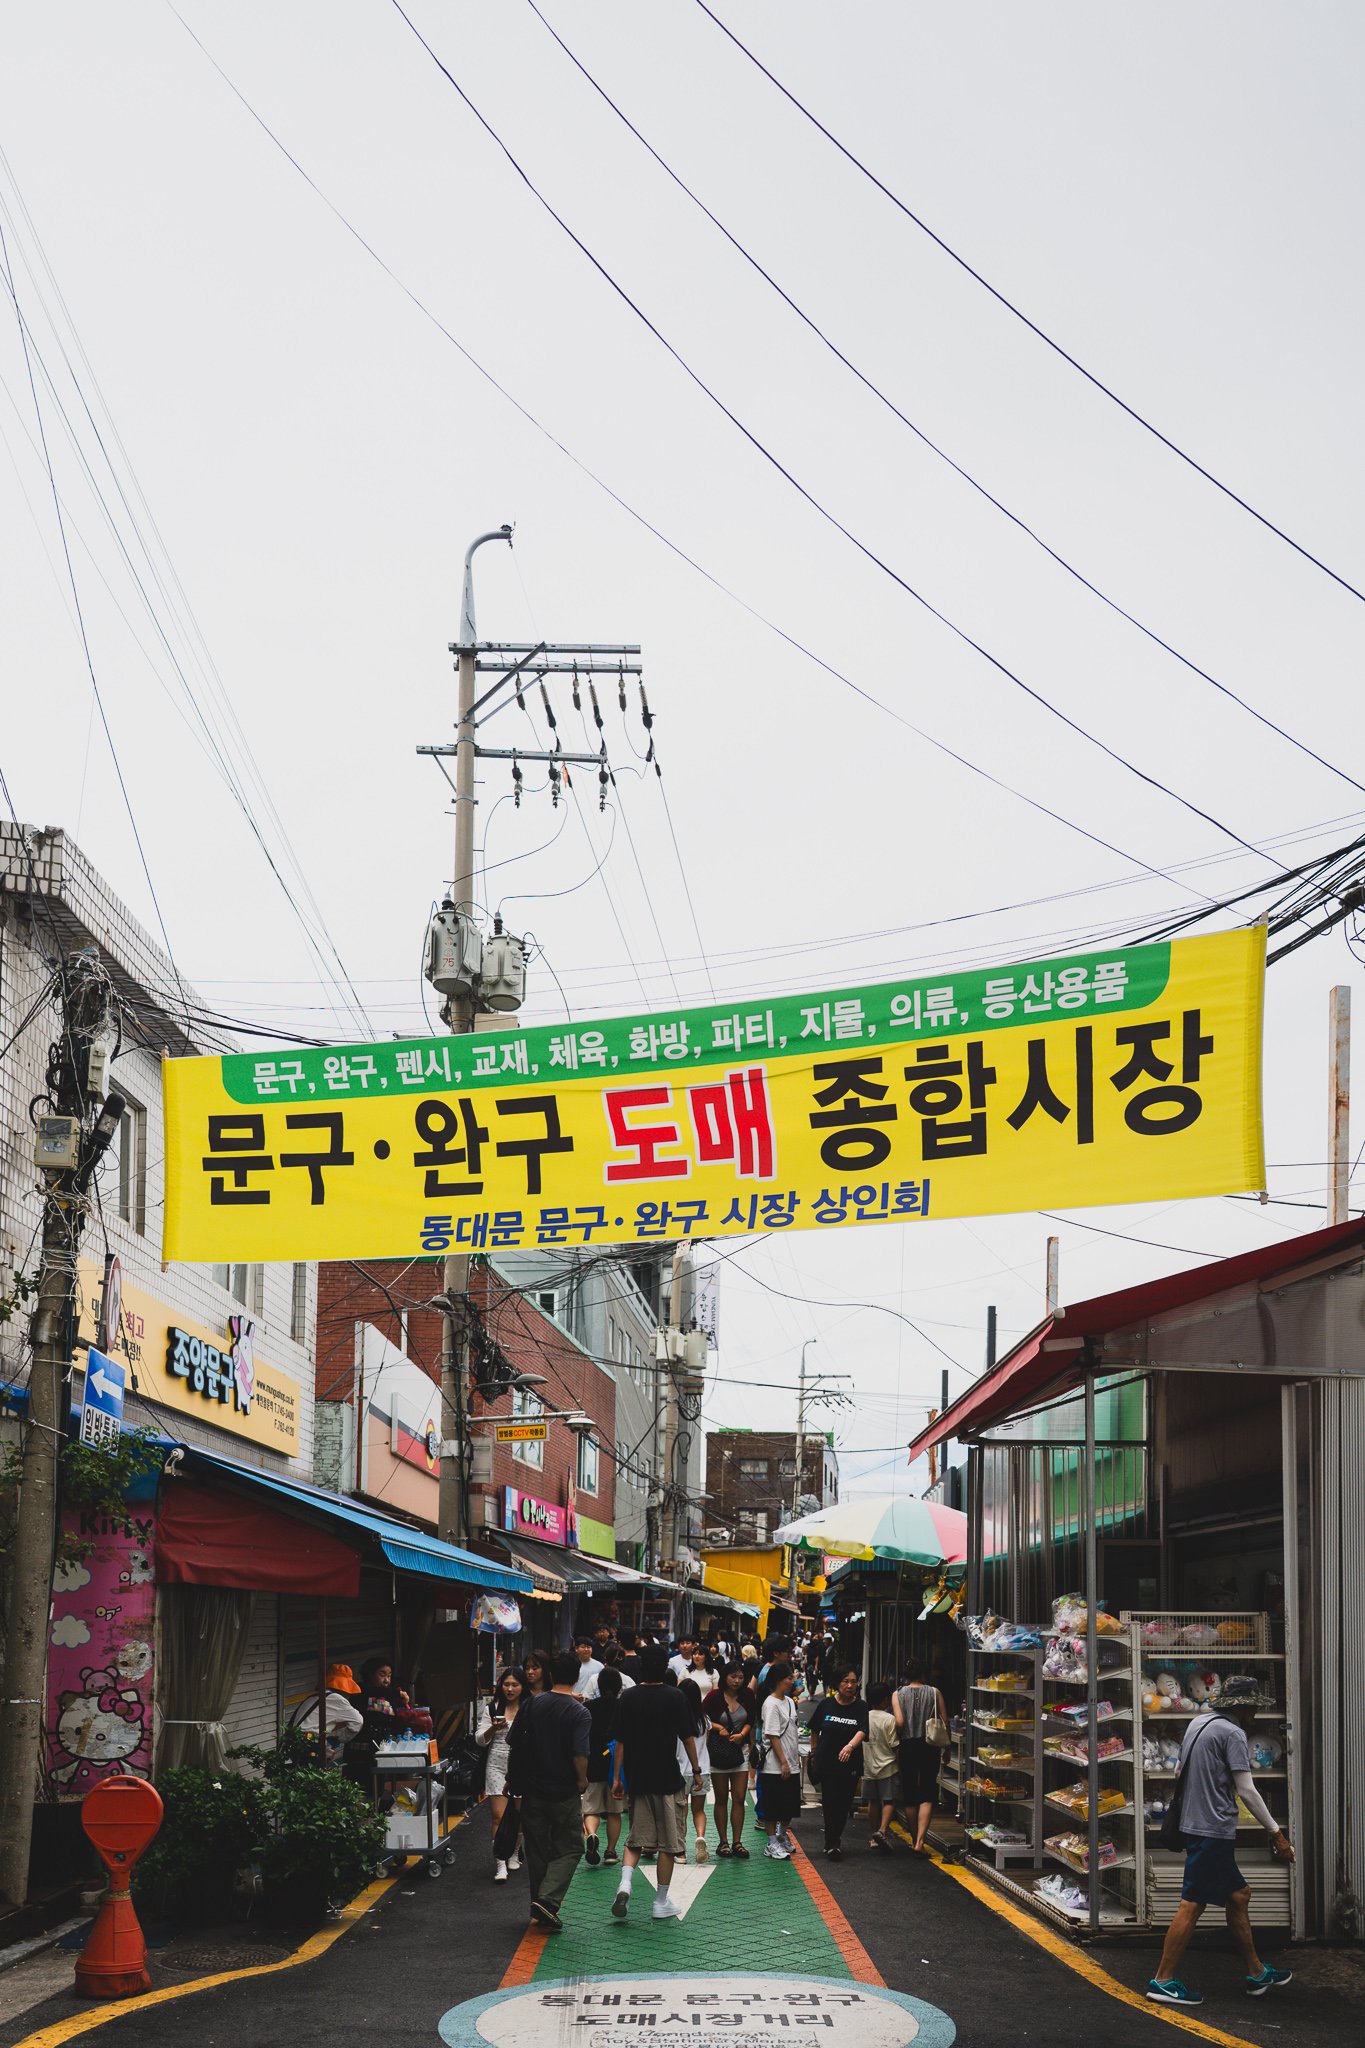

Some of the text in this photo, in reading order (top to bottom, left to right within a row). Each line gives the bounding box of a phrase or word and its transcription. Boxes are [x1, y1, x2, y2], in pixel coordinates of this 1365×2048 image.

[442, 957, 455, 968] 75
[252, 961, 1130, 1095] 문구, 완구, 펜시, 교재, 체육, 화방, 파티, 지물, 의류, 등산용품
[202, 1009, 1214, 1206] 문구·완구 도매 종합시장
[419, 1179, 931, 1251] 동대문 문구·완구 시장 상인회
[170, 1328, 234, 1404] 조양문구
[538, 1993, 666, 2007] 동대문
[571, 2013, 835, 2028] 도매시장거리
